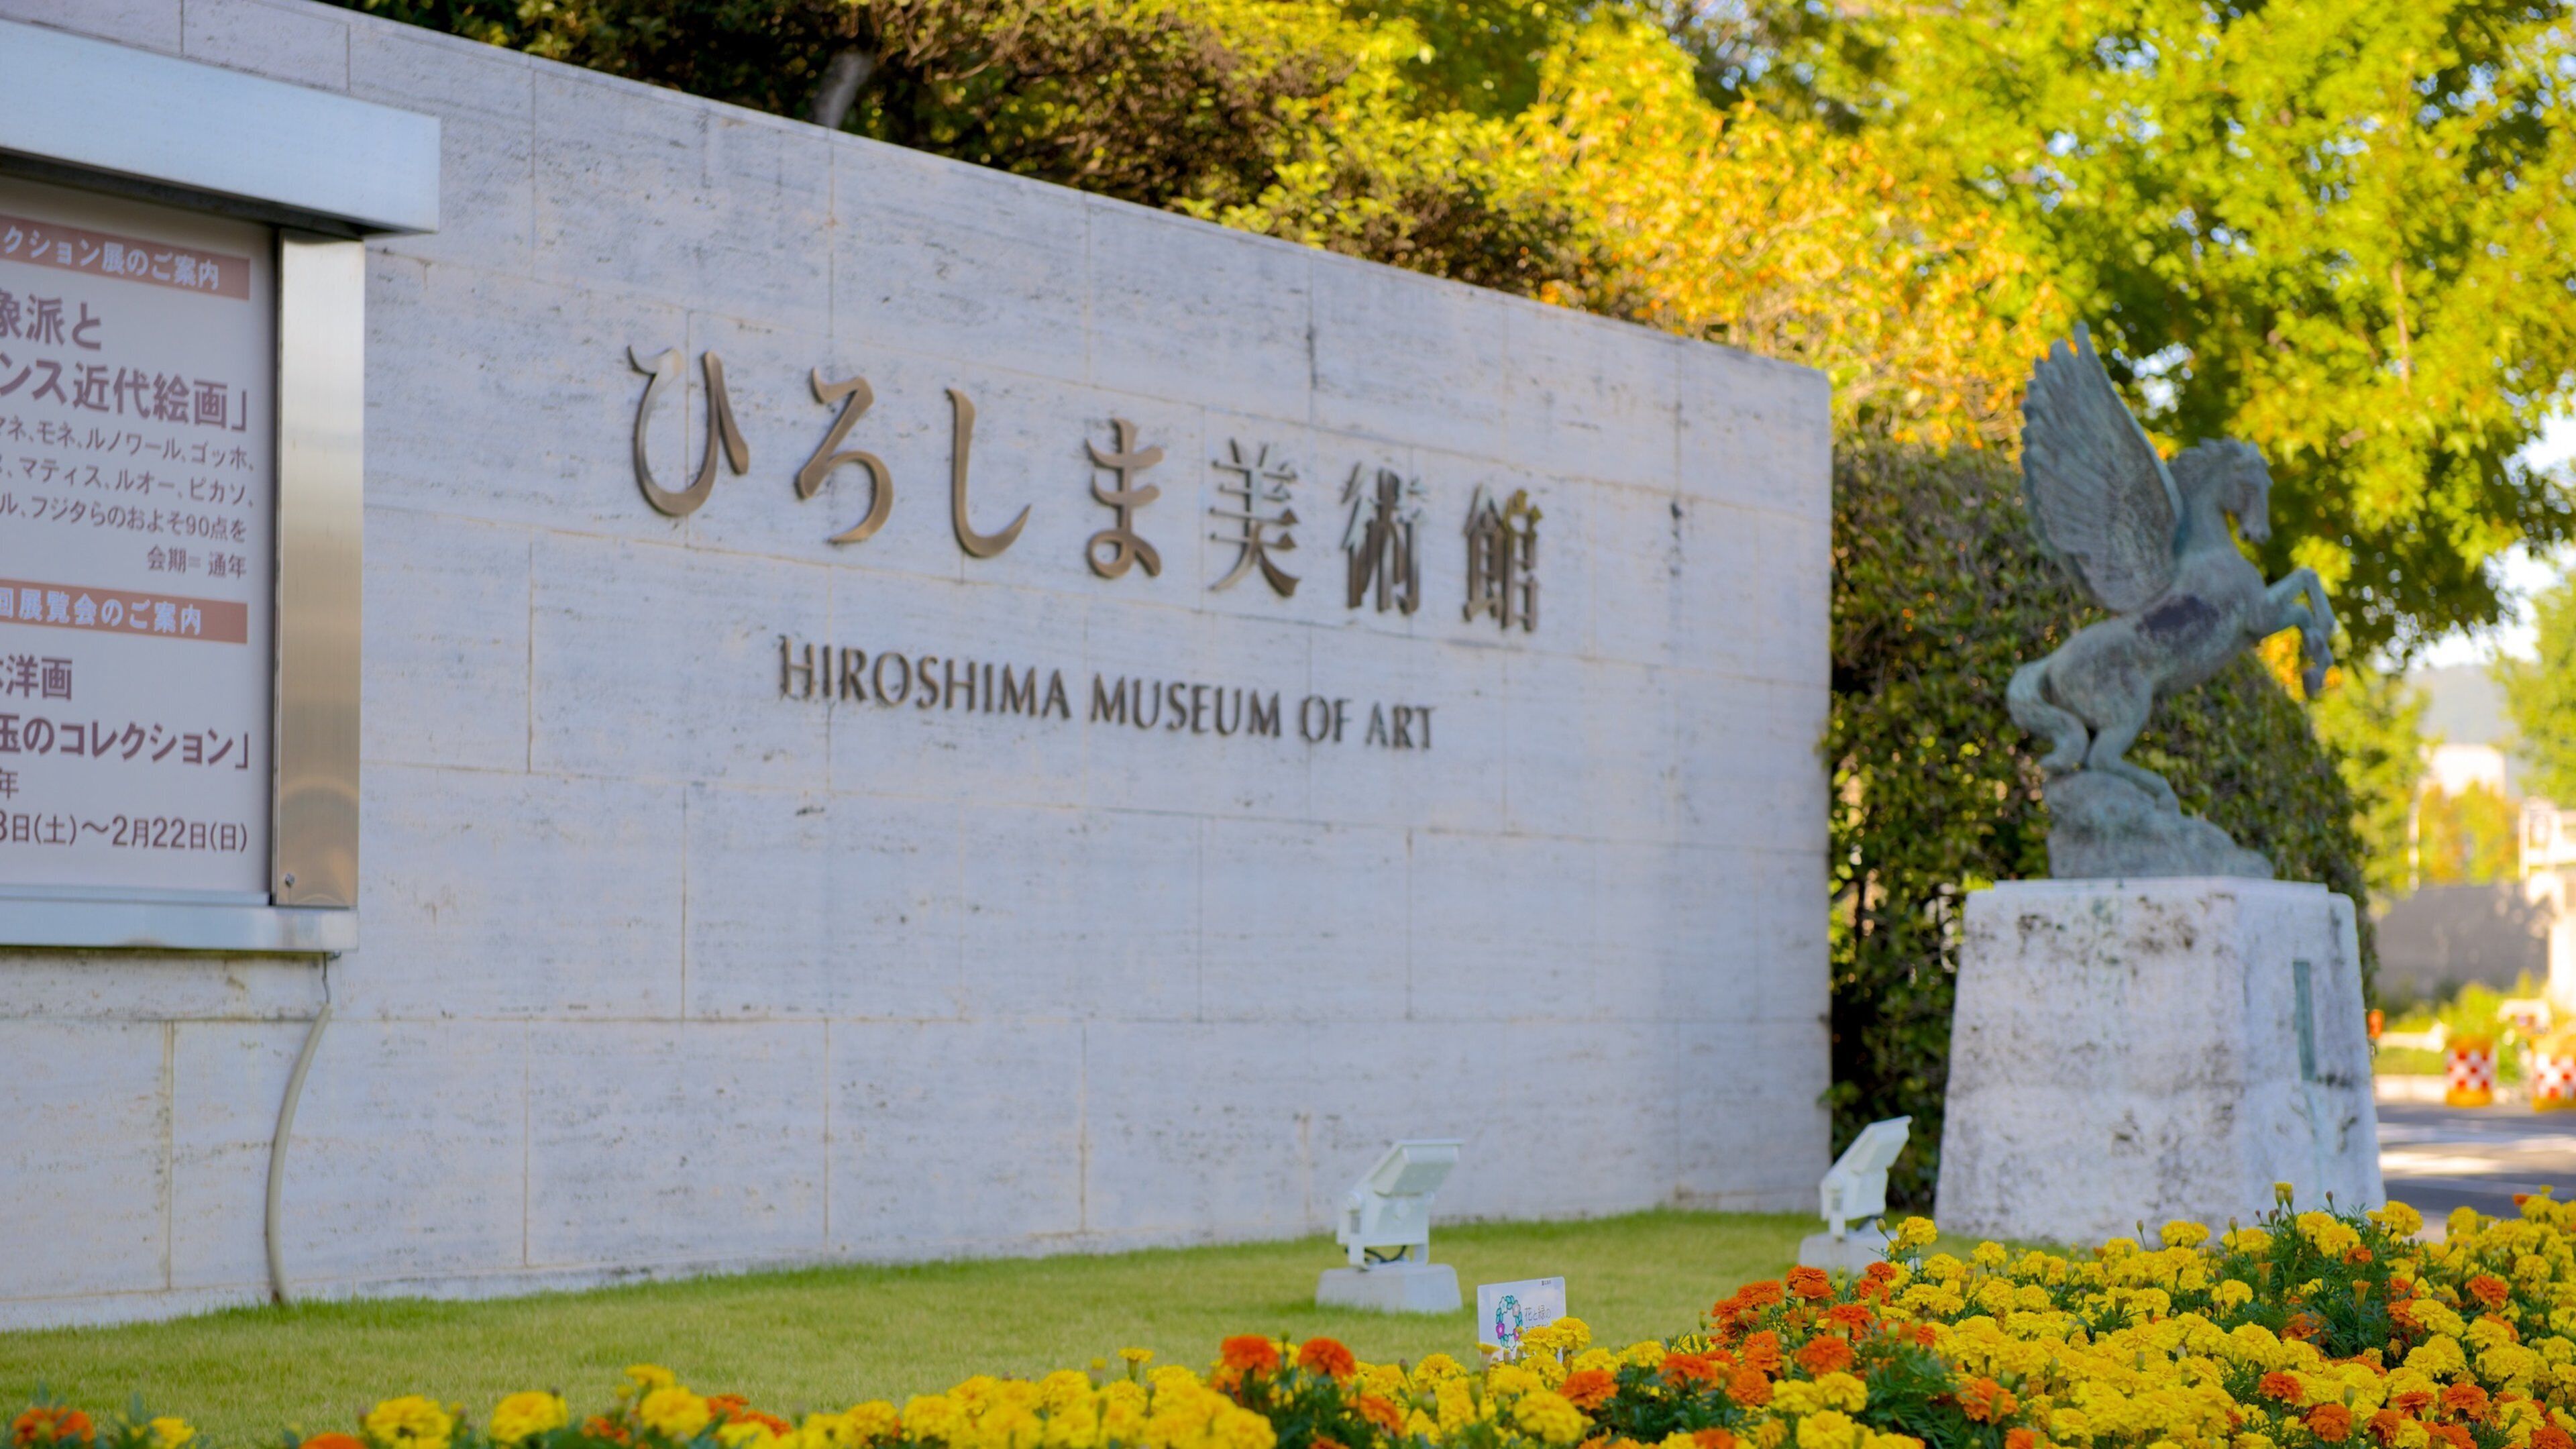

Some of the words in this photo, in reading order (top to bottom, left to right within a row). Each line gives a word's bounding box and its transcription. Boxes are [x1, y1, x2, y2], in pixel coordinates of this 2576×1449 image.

[3, 225, 220, 290] クション展のご案内
[0, 453, 254, 508] 、マティス、ルオー、ピカソ、
[628, 345, 1543, 632] ひろしま美術館
[0, 654, 72, 701] 洋画
[780, 635, 1071, 718] HIROSHIMA
[1090, 673, 1283, 737] MUSEUM
[1299, 695, 1354, 742] OF
[1366, 702, 1436, 749] ART
